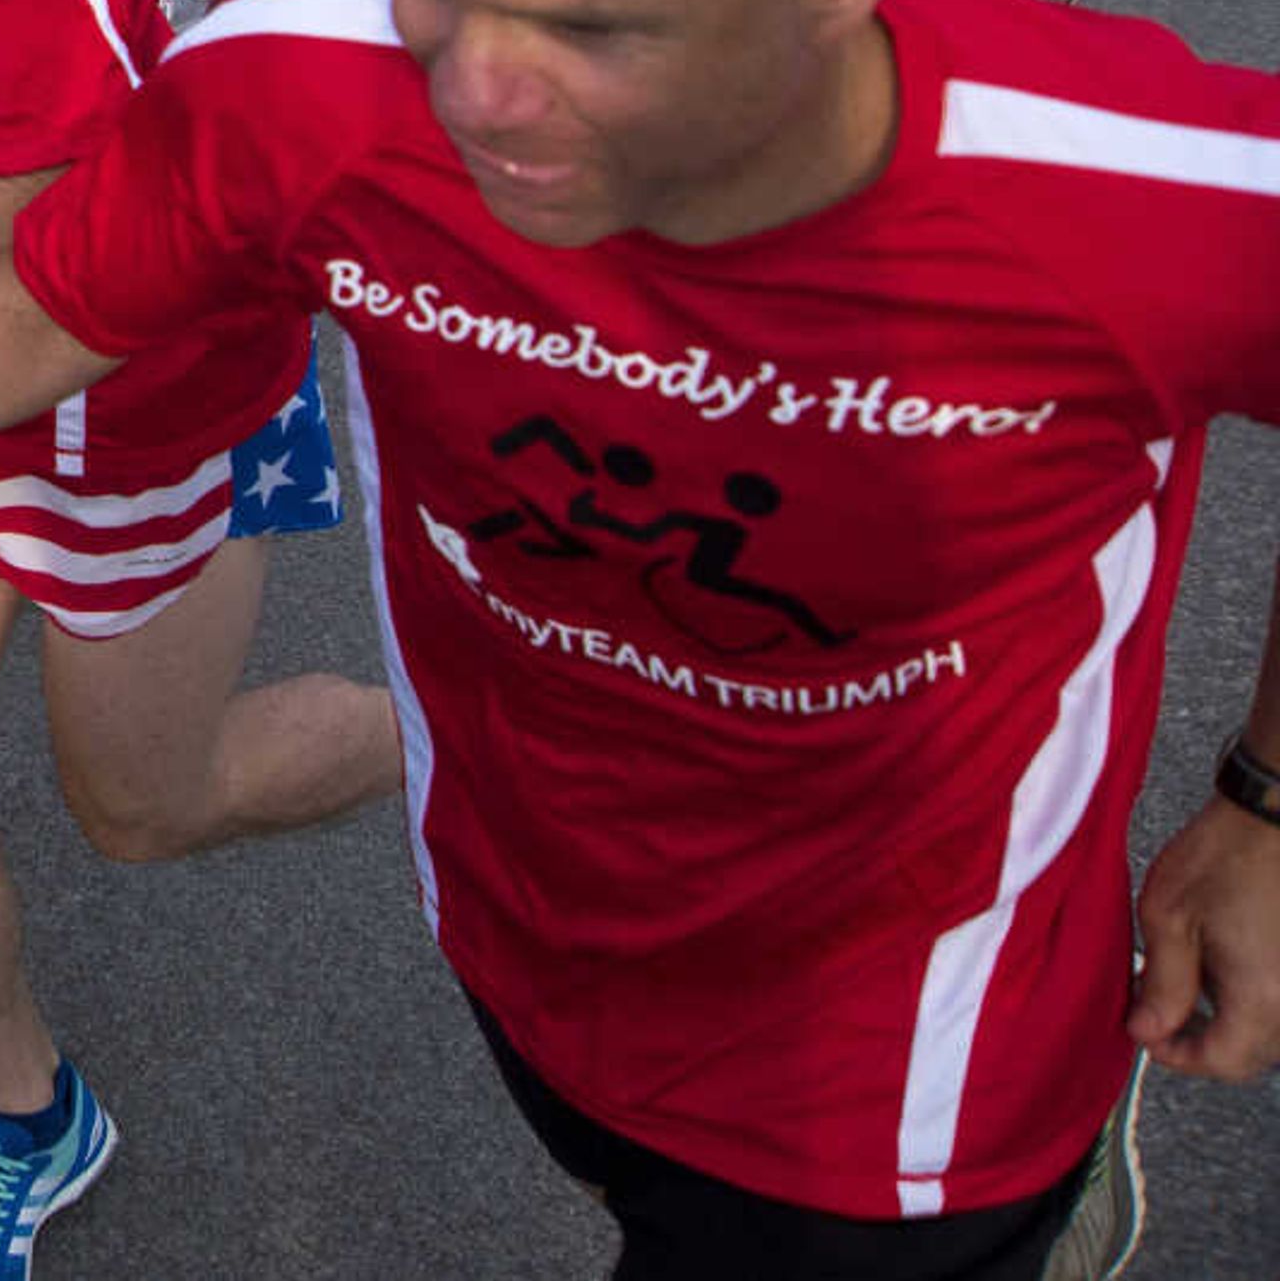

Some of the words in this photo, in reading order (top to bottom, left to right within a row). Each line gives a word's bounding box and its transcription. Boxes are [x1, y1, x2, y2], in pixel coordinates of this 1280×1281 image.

[324, 258, 404, 317] Be
[403, 283, 819, 425] Somebody's
[823, 374, 1057, 438] Hero!
[486, 591, 700, 699] myTEAM
[703, 639, 967, 715] TRIUMPH
